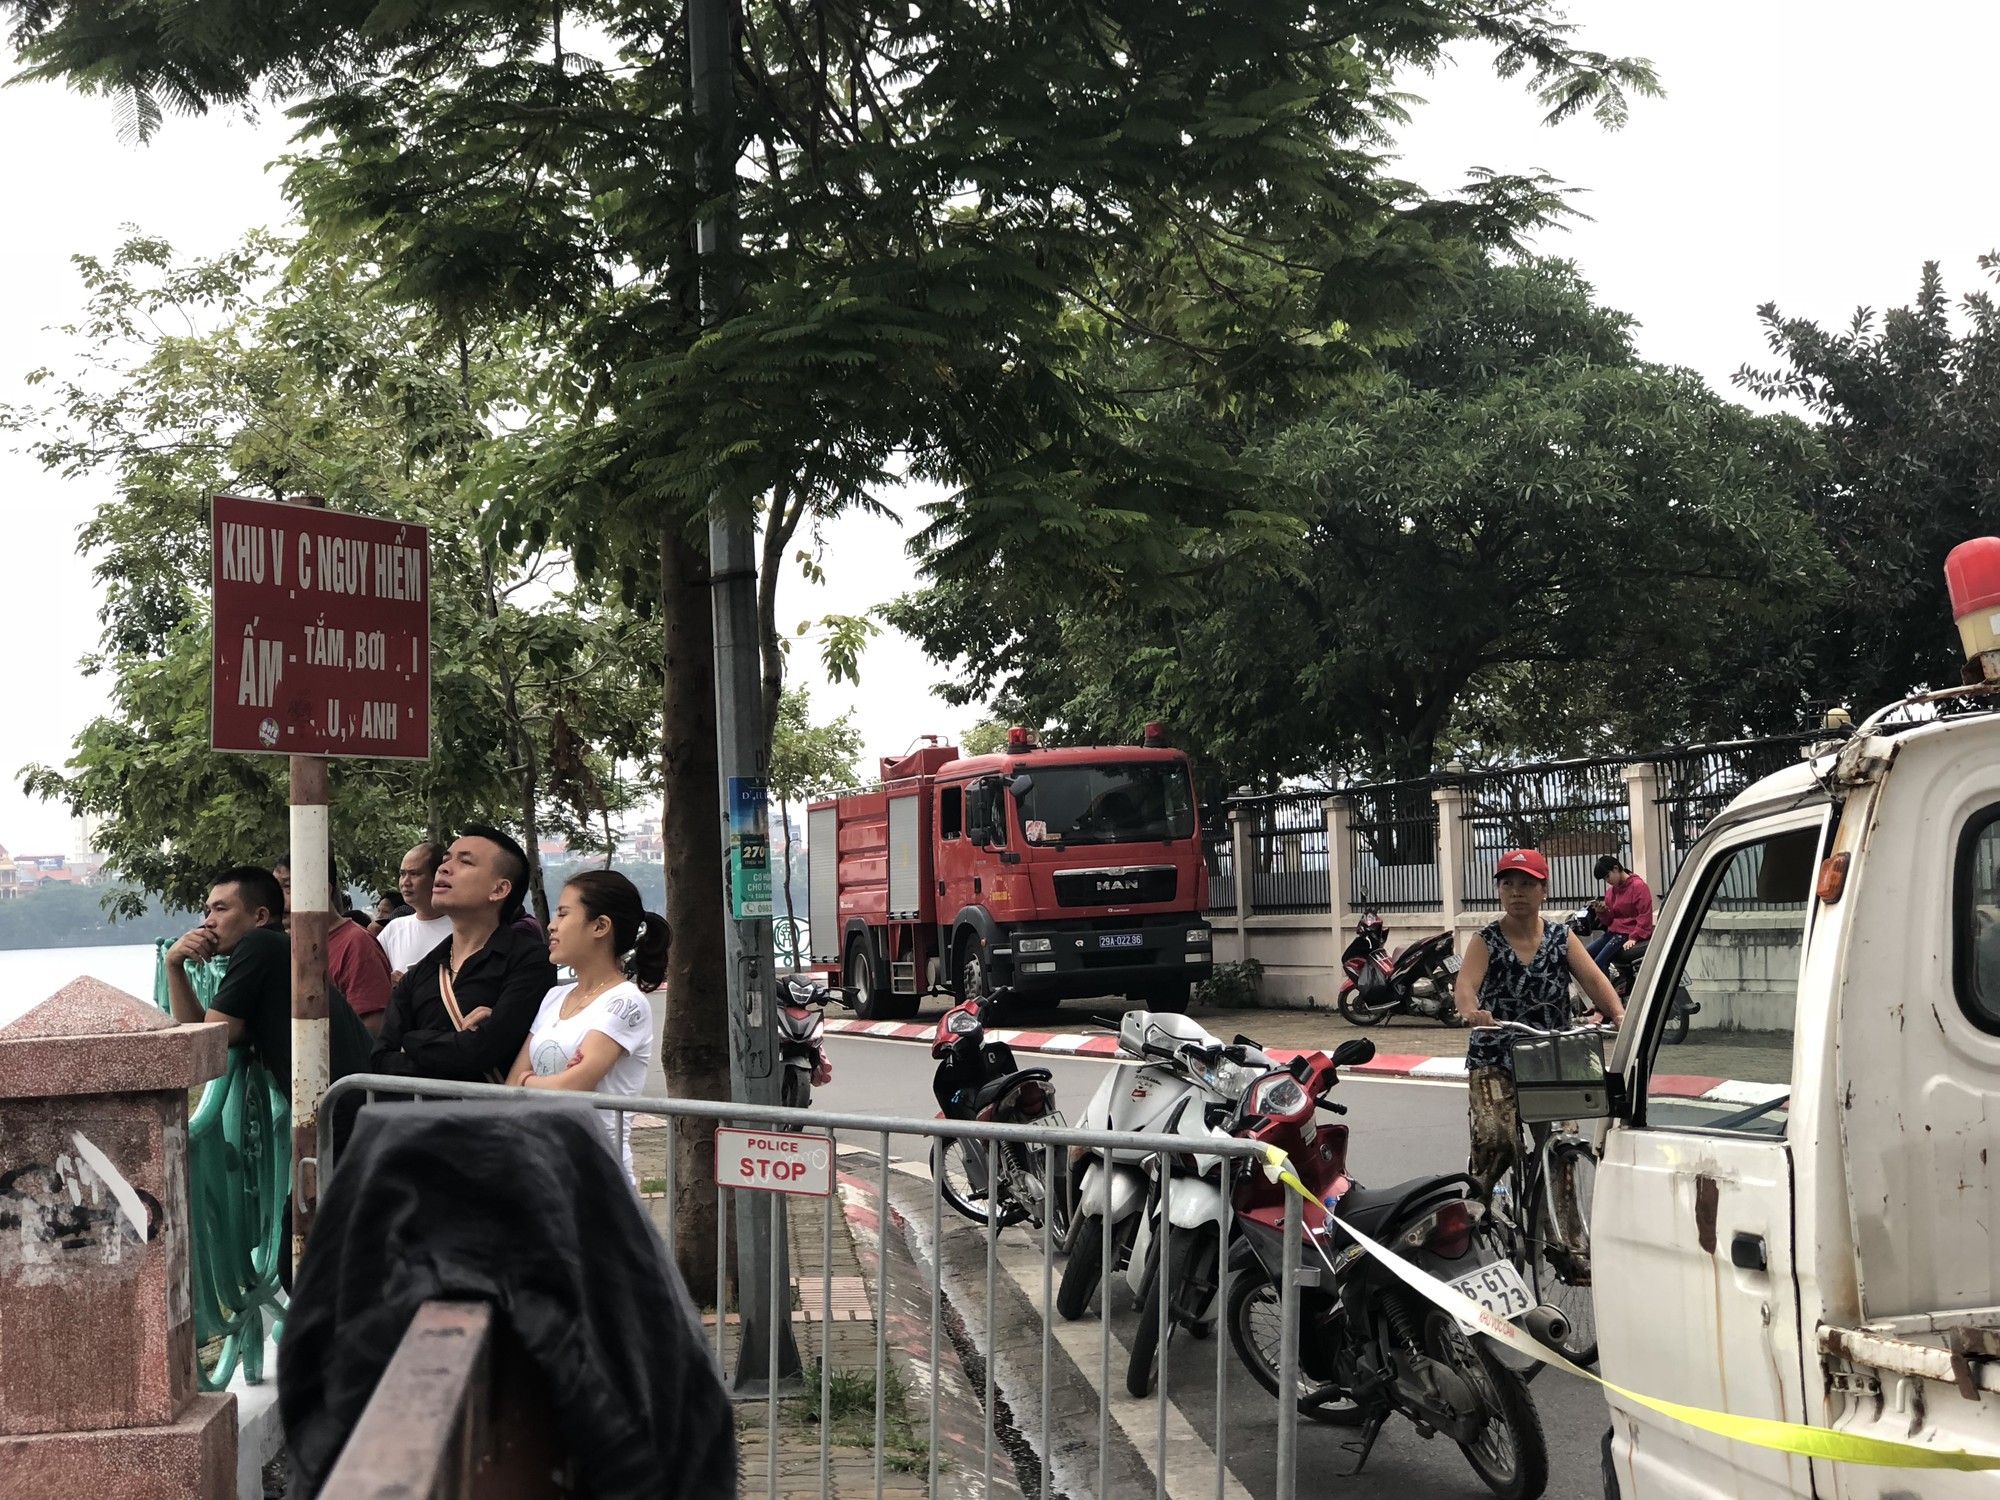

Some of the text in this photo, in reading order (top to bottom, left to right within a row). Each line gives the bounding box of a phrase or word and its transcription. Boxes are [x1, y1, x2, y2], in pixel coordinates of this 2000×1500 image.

[222, 522, 421, 602] KHU VC NGUY HIỂM
[221, 616, 283, 708] ẤM
[1096, 880, 1139, 891] MAN
[747, 1138, 799, 1153] POLICE
[739, 1157, 807, 1182] STOP
